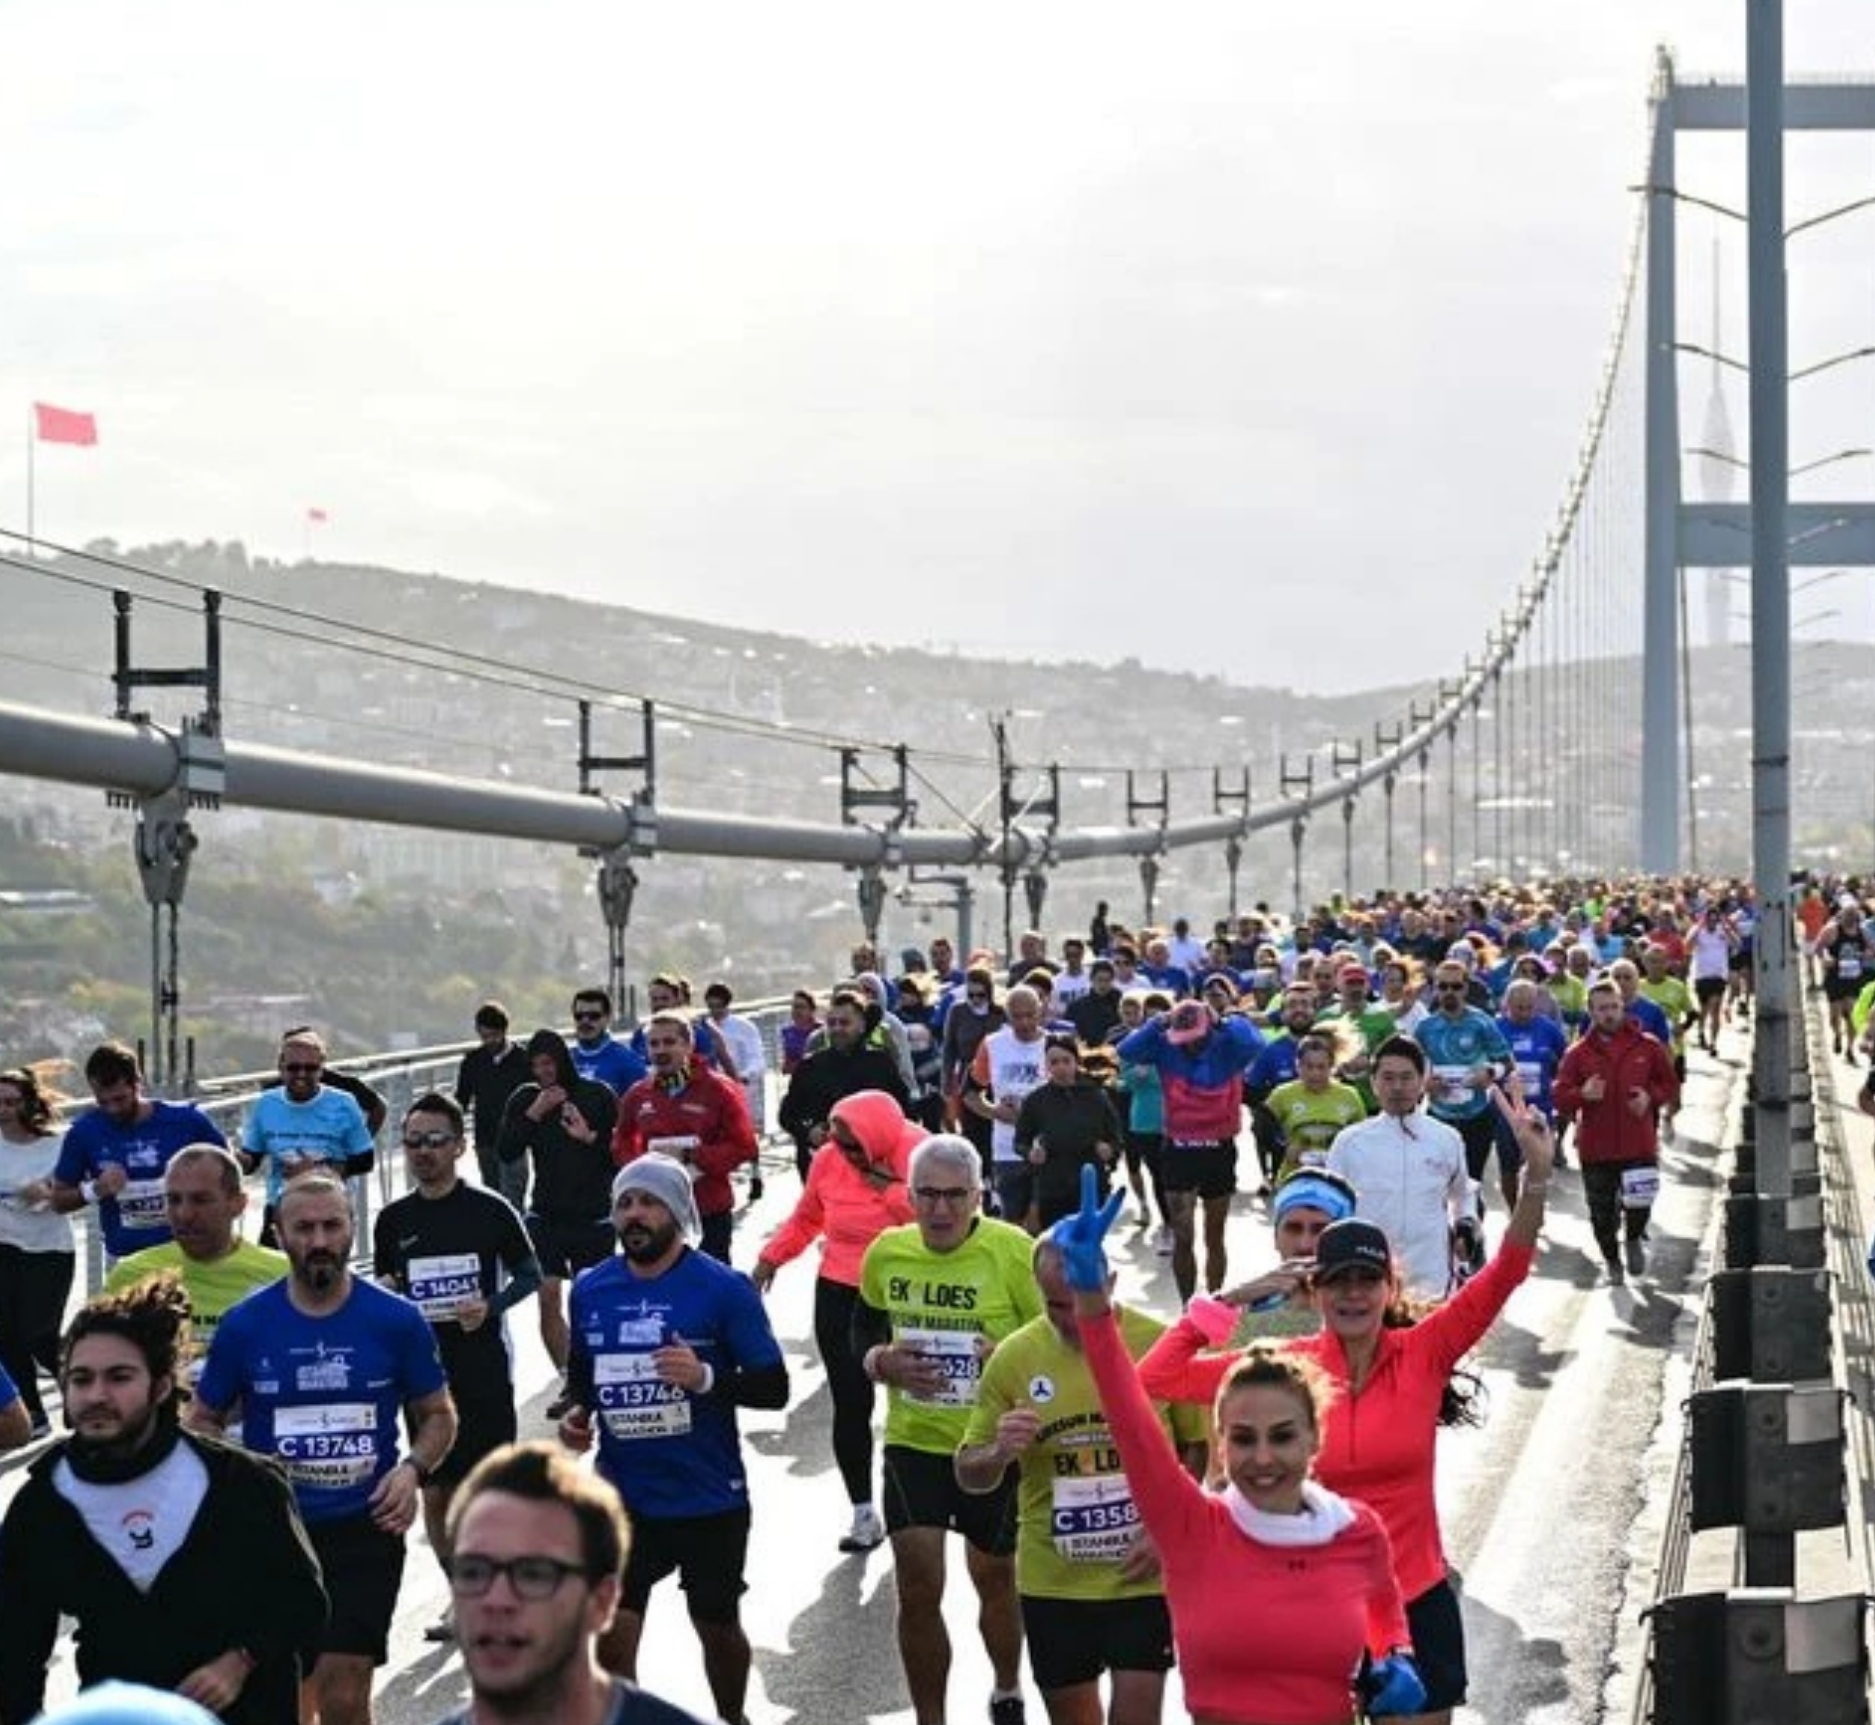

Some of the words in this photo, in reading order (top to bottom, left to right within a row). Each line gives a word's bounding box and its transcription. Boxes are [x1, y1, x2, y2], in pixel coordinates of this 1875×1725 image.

[411, 1281, 425, 1298] C
[599, 1385, 614, 1406] C
[278, 1437, 298, 1457] C
[304, 1434, 374, 1457] 13748
[1055, 1510, 1075, 1532] C
[1080, 1502, 1139, 1529] 1358
